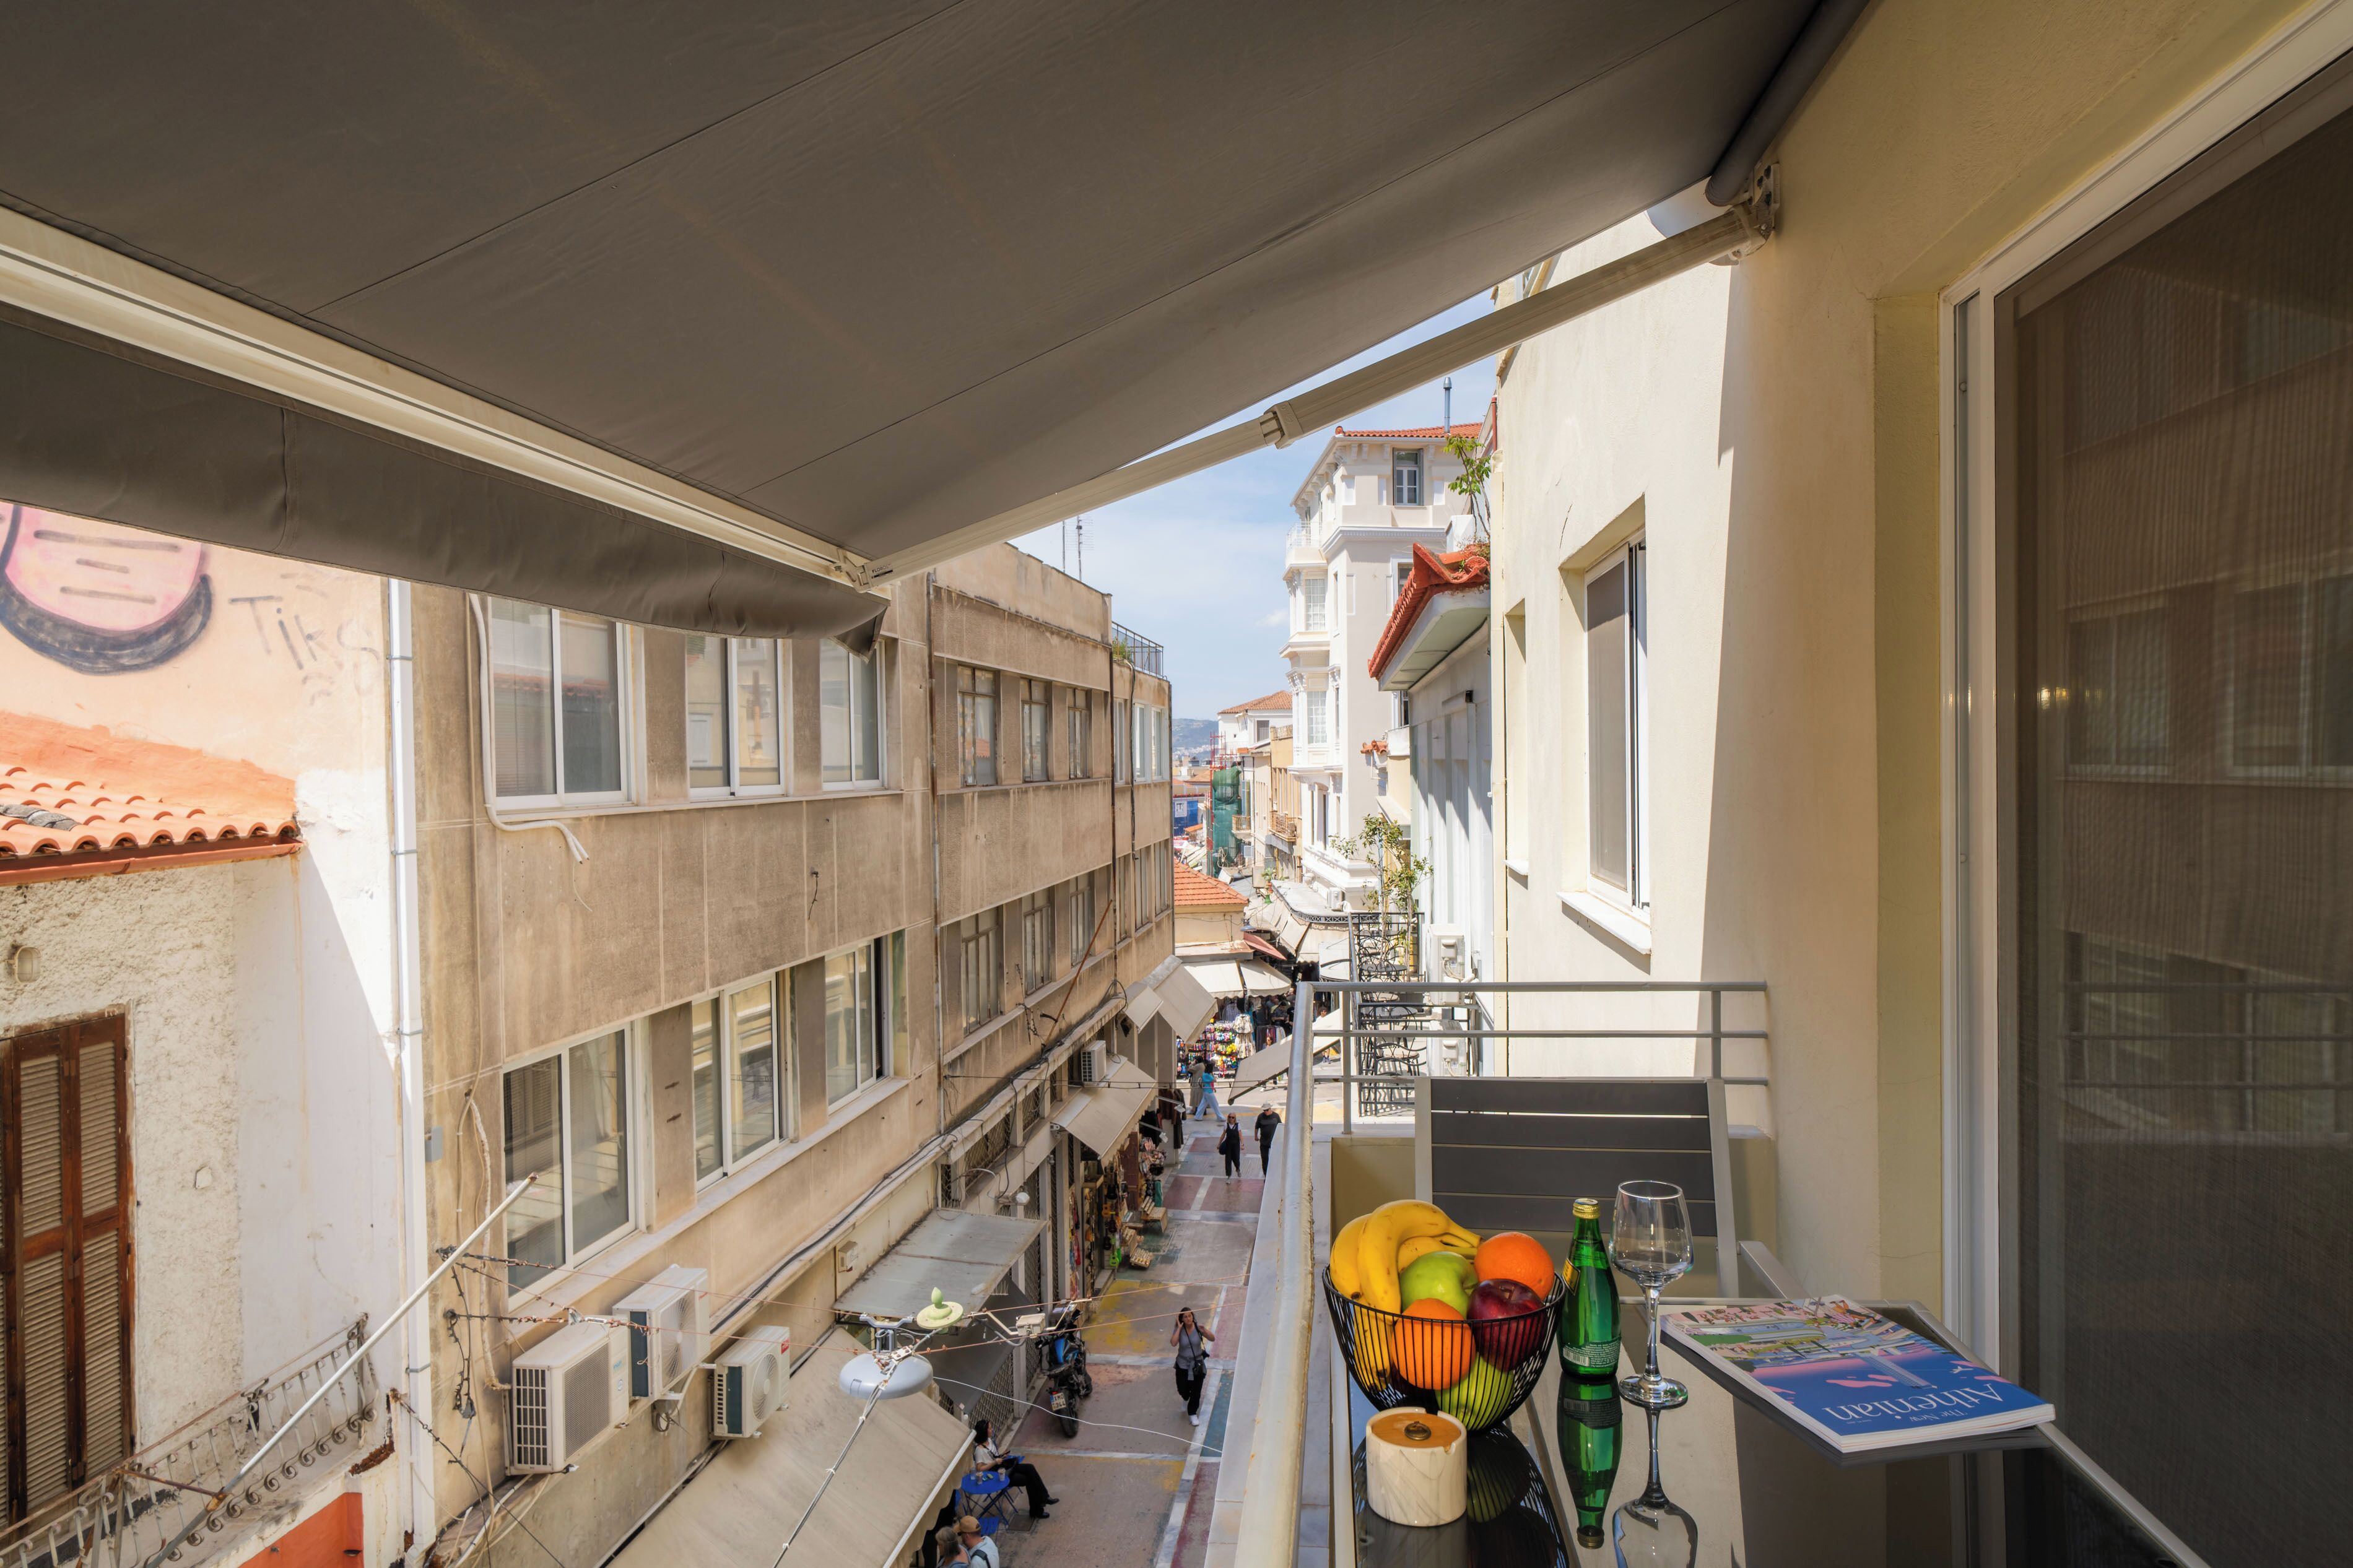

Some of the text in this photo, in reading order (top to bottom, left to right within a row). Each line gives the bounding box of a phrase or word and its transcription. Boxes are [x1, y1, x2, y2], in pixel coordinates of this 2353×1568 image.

[1822, 1383, 2004, 1421] Athenian
[1910, 1410, 1968, 1422] The New
